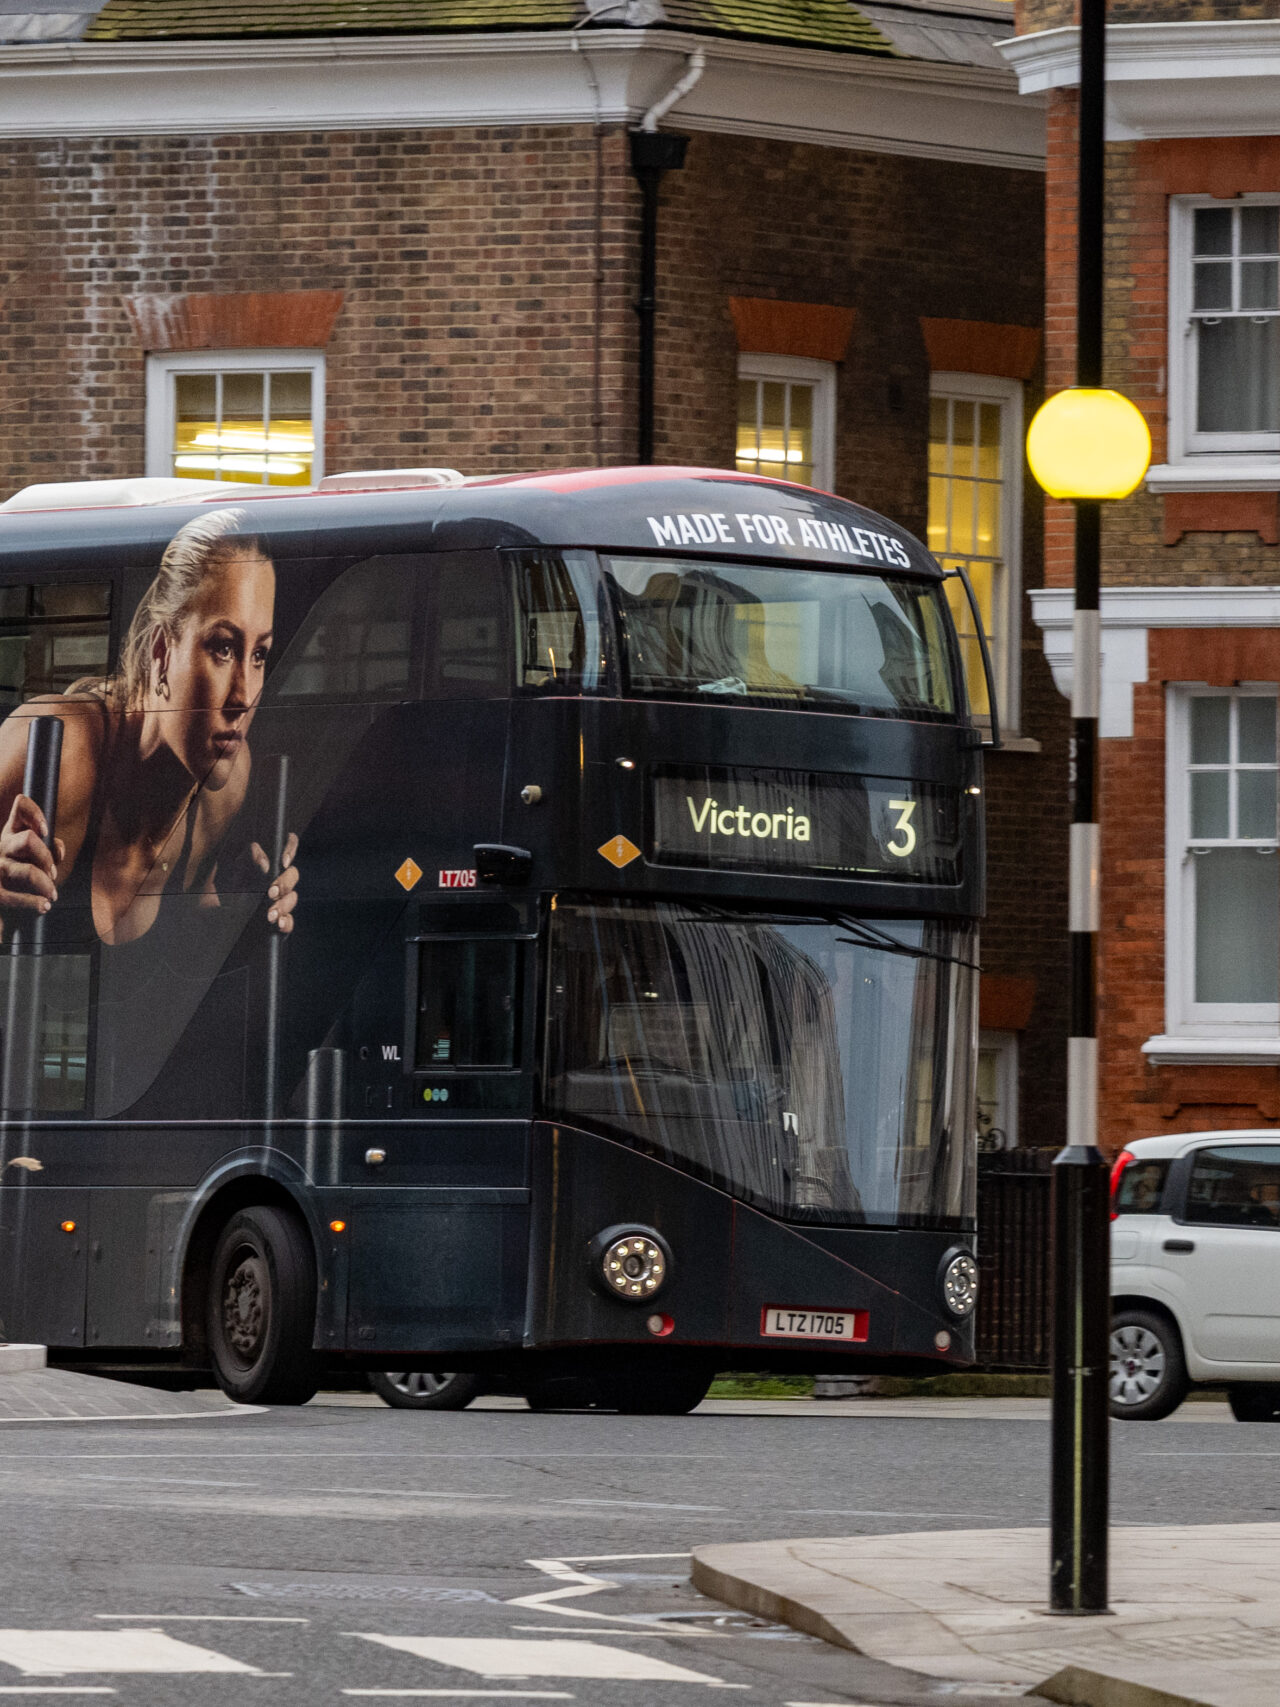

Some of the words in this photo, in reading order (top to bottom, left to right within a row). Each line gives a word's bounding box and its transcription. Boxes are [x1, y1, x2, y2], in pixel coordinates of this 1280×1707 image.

[647, 512, 735, 547] MADE
[735, 513, 796, 547] FOR
[800, 518, 911, 569] ATHLETES
[686, 796, 811, 842] Victoria
[886, 799, 917, 858] 3
[438, 869, 477, 888] LT705
[381, 1045, 401, 1061] WL
